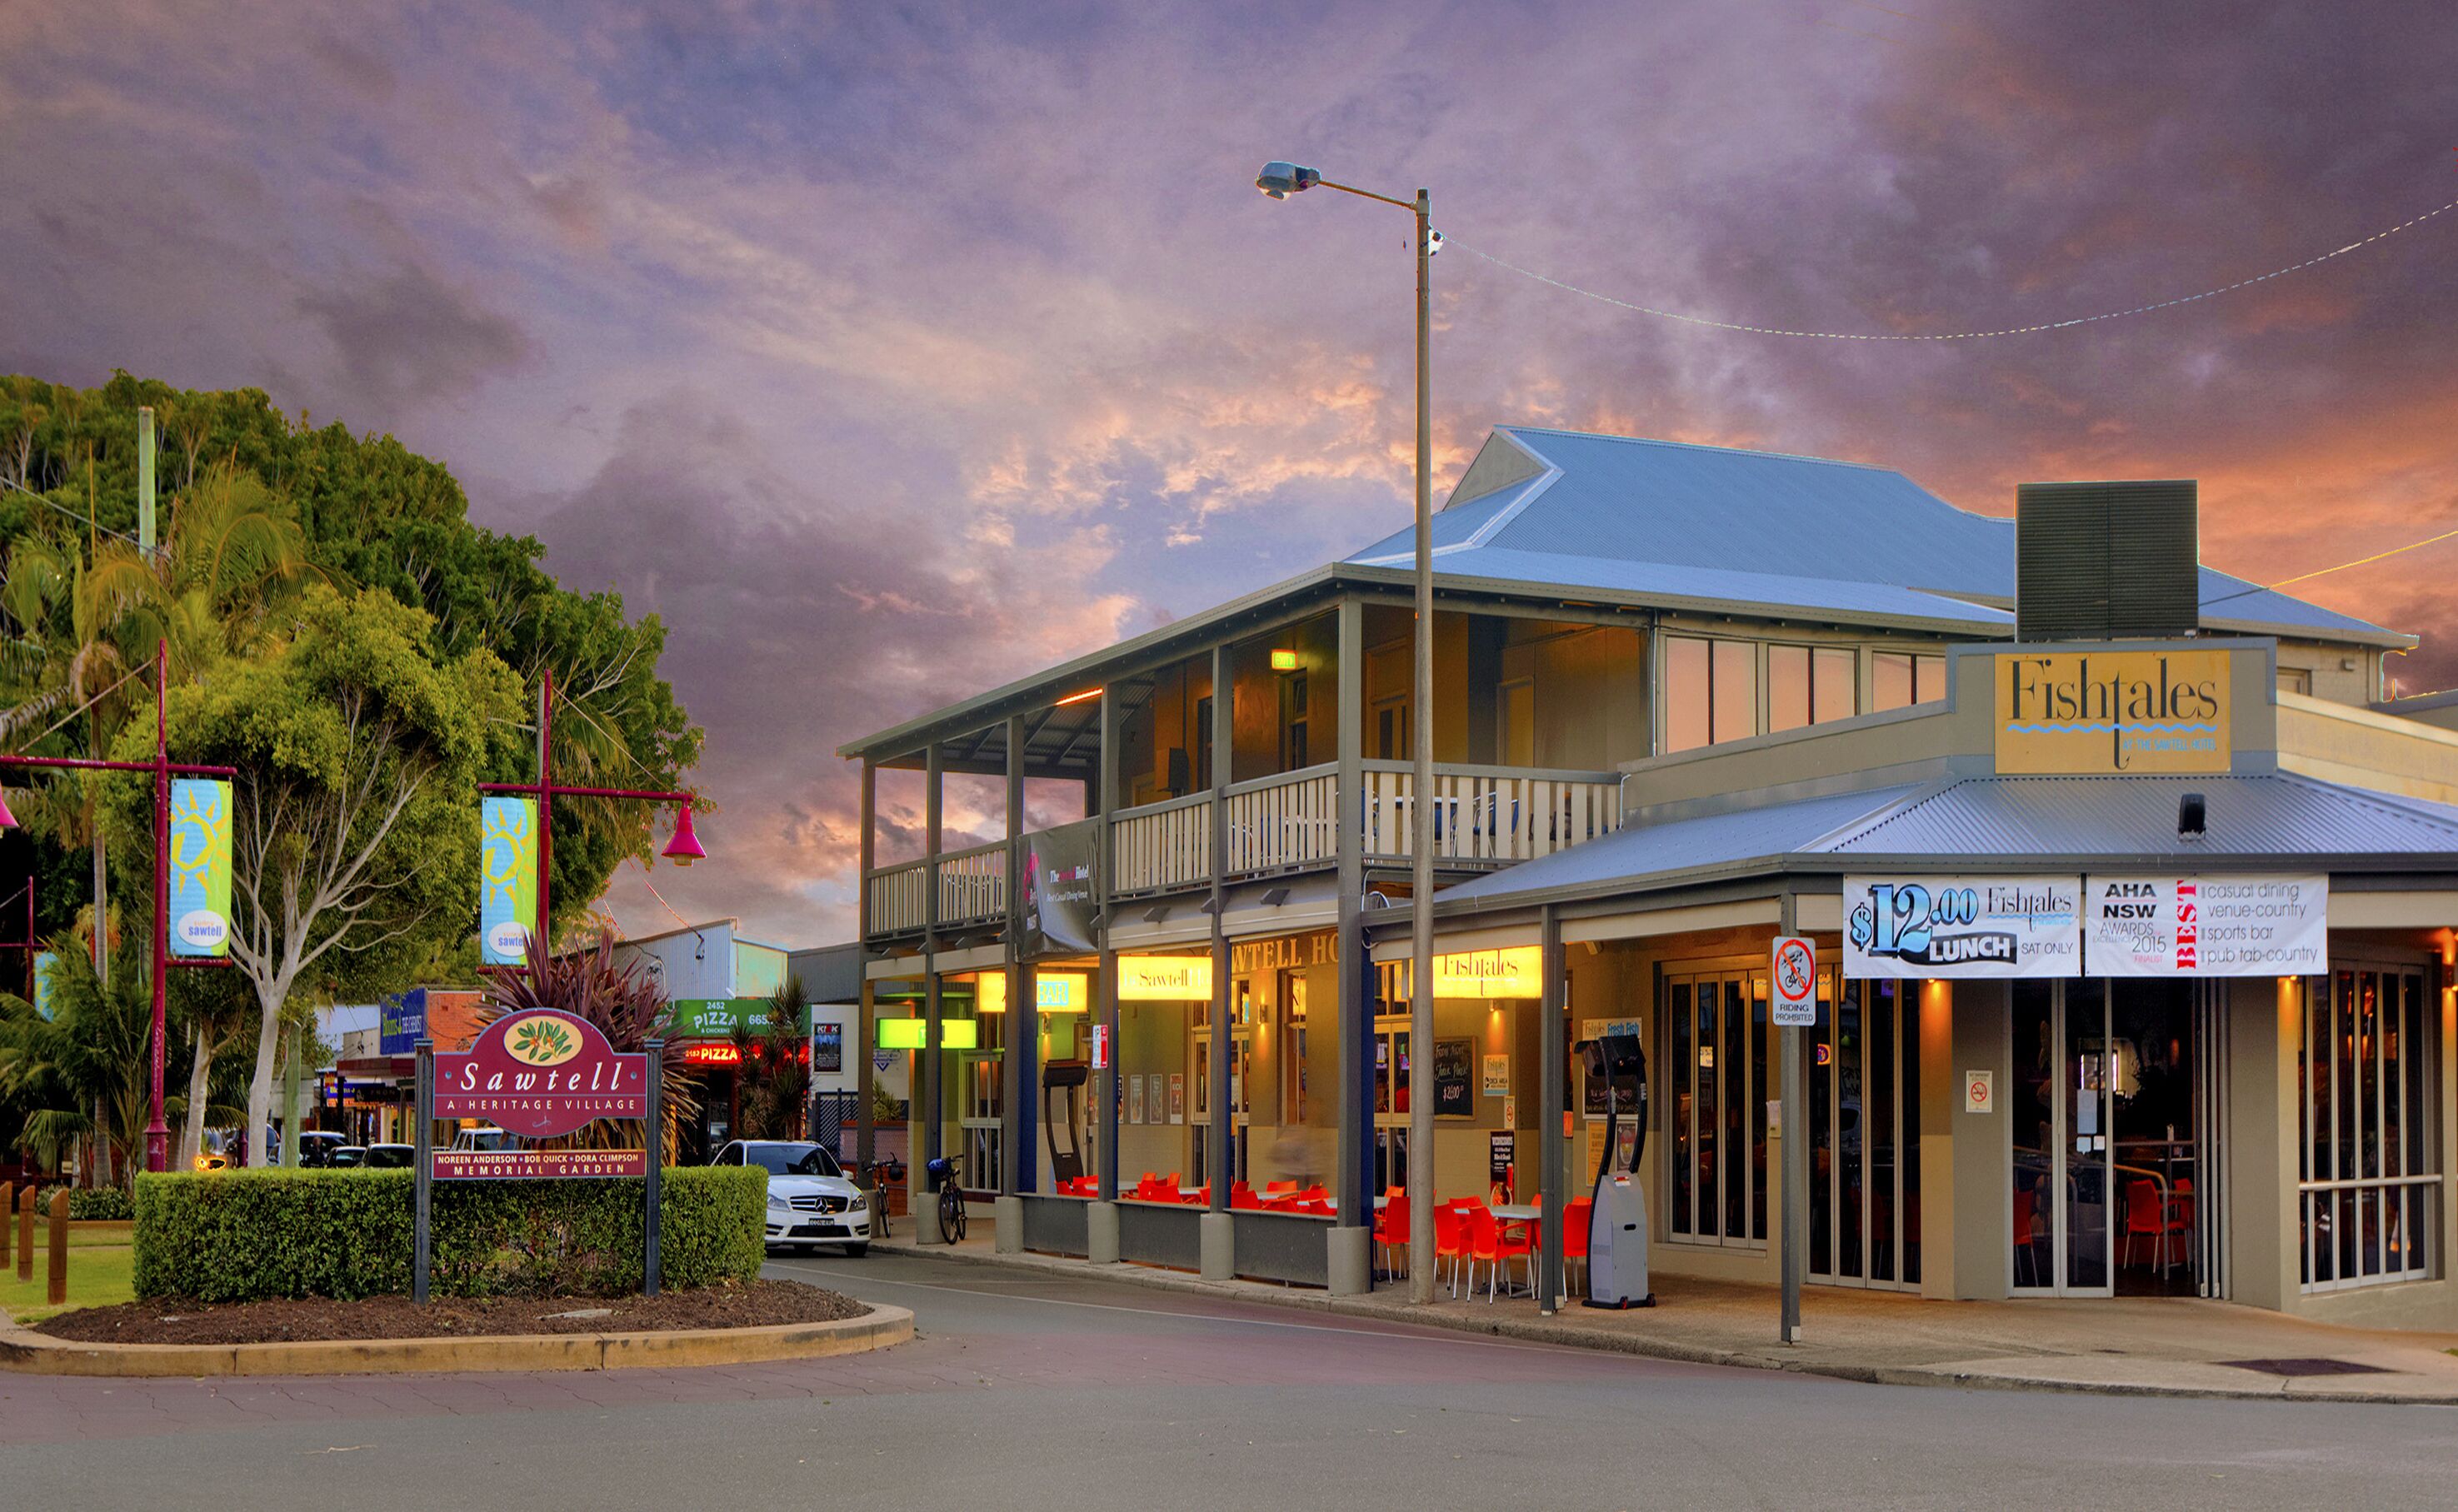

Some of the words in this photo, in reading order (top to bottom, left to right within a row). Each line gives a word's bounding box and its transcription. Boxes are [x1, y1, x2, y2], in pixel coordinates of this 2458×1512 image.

[2007, 656, 2218, 771] Fishtales
[2122, 738, 2133, 751] AT
[2136, 738, 2151, 751] THE
[2154, 738, 2187, 751] SAWTELL
[2191, 738, 2216, 751] HOTEL
[1050, 869, 1059, 883] The
[1075, 864, 1089, 880] Hotel
[2105, 883, 2157, 897] AHA
[2208, 885, 2254, 899] casual
[2257, 883, 2300, 901] dining
[1987, 886, 2072, 933] Fishtales
[2103, 905, 2157, 919] NSW
[2208, 902, 2306, 921] venue-country
[1850, 884, 1979, 958] $12.00
[2100, 921, 2154, 936] AWARDS
[2176, 880, 2196, 970] BEST
[188, 926, 222, 936] sawtell
[2208, 925, 2247, 942] sports
[2251, 925, 2273, 941] bar
[498, 936, 524, 947] sawte
[1929, 936, 2011, 961] LUNCH
[2021, 943, 2041, 955] SAT
[2044, 942, 2074, 954] ONLY
[2131, 936, 2166, 953] 2015
[1231, 938, 1301, 973] WTELL
[1311, 933, 1338, 965] HO
[2134, 954, 2164, 964] FINALIST
[2208, 947, 2236, 964] pub
[2239, 946, 2318, 965] tab-country
[1139, 968, 1188, 987] Sawtell
[1038, 983, 1067, 1004] BAR
[707, 1001, 725, 1010] 2452
[1780, 1003, 1809, 1012] RIDING
[693, 1011, 737, 1029] PIZZA
[748, 1014, 771, 1025] 665
[1776, 1013, 1813, 1023] PROHIBITED
[701, 1047, 737, 1060] PIZZA
[461, 1061, 622, 1091] Sawtell
[447, 1100, 455, 1110] A
[468, 1100, 552, 1110] HERITAGE
[565, 1099, 635, 1110] VILLAGE
[437, 1155, 471, 1164] NOREEN
[472, 1155, 517, 1164] ANDERSON
[524, 1155, 541, 1164] BOB
[542, 1155, 567, 1164] QUICK
[575, 1154, 597, 1163] DORA
[599, 1154, 638, 1163] CLIMPSON
[454, 1165, 543, 1175] MEMORIAL
[559, 1164, 625, 1175] GARDEN
